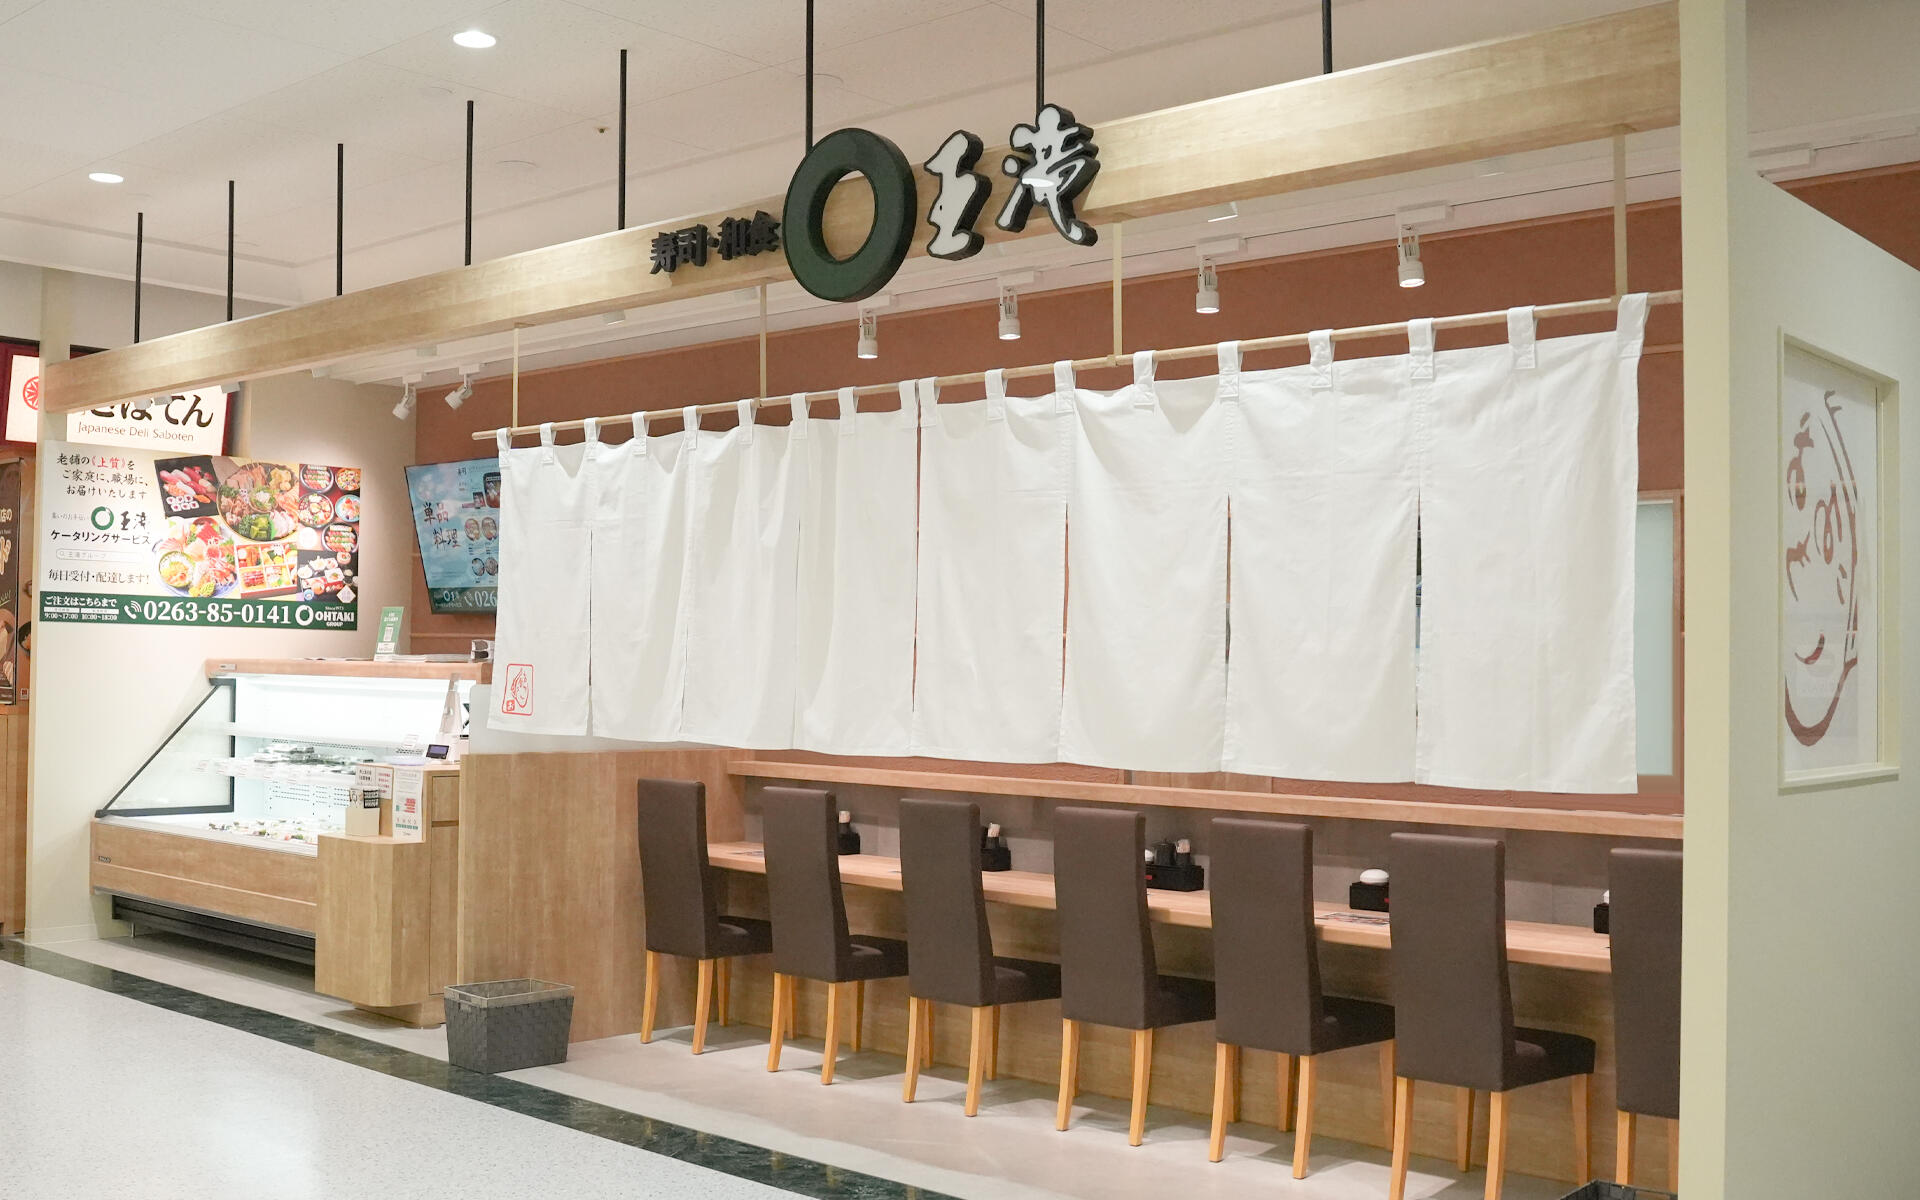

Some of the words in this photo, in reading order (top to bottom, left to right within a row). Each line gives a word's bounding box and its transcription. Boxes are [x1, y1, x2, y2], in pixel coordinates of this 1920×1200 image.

[650, 210, 780, 274] 寿司・和食
[78, 421, 126, 435] Japanese
[129, 426, 149, 437] Deli
[152, 429, 194, 442] Saboten
[66, 485, 148, 499] お届けいたします
[50, 529, 150, 545] ケータリングサービス
[45, 595, 118, 608] ご注文はこちらまで
[144, 600, 292, 625] 0263-85-0141
[315, 610, 355, 622] OHTAKI
